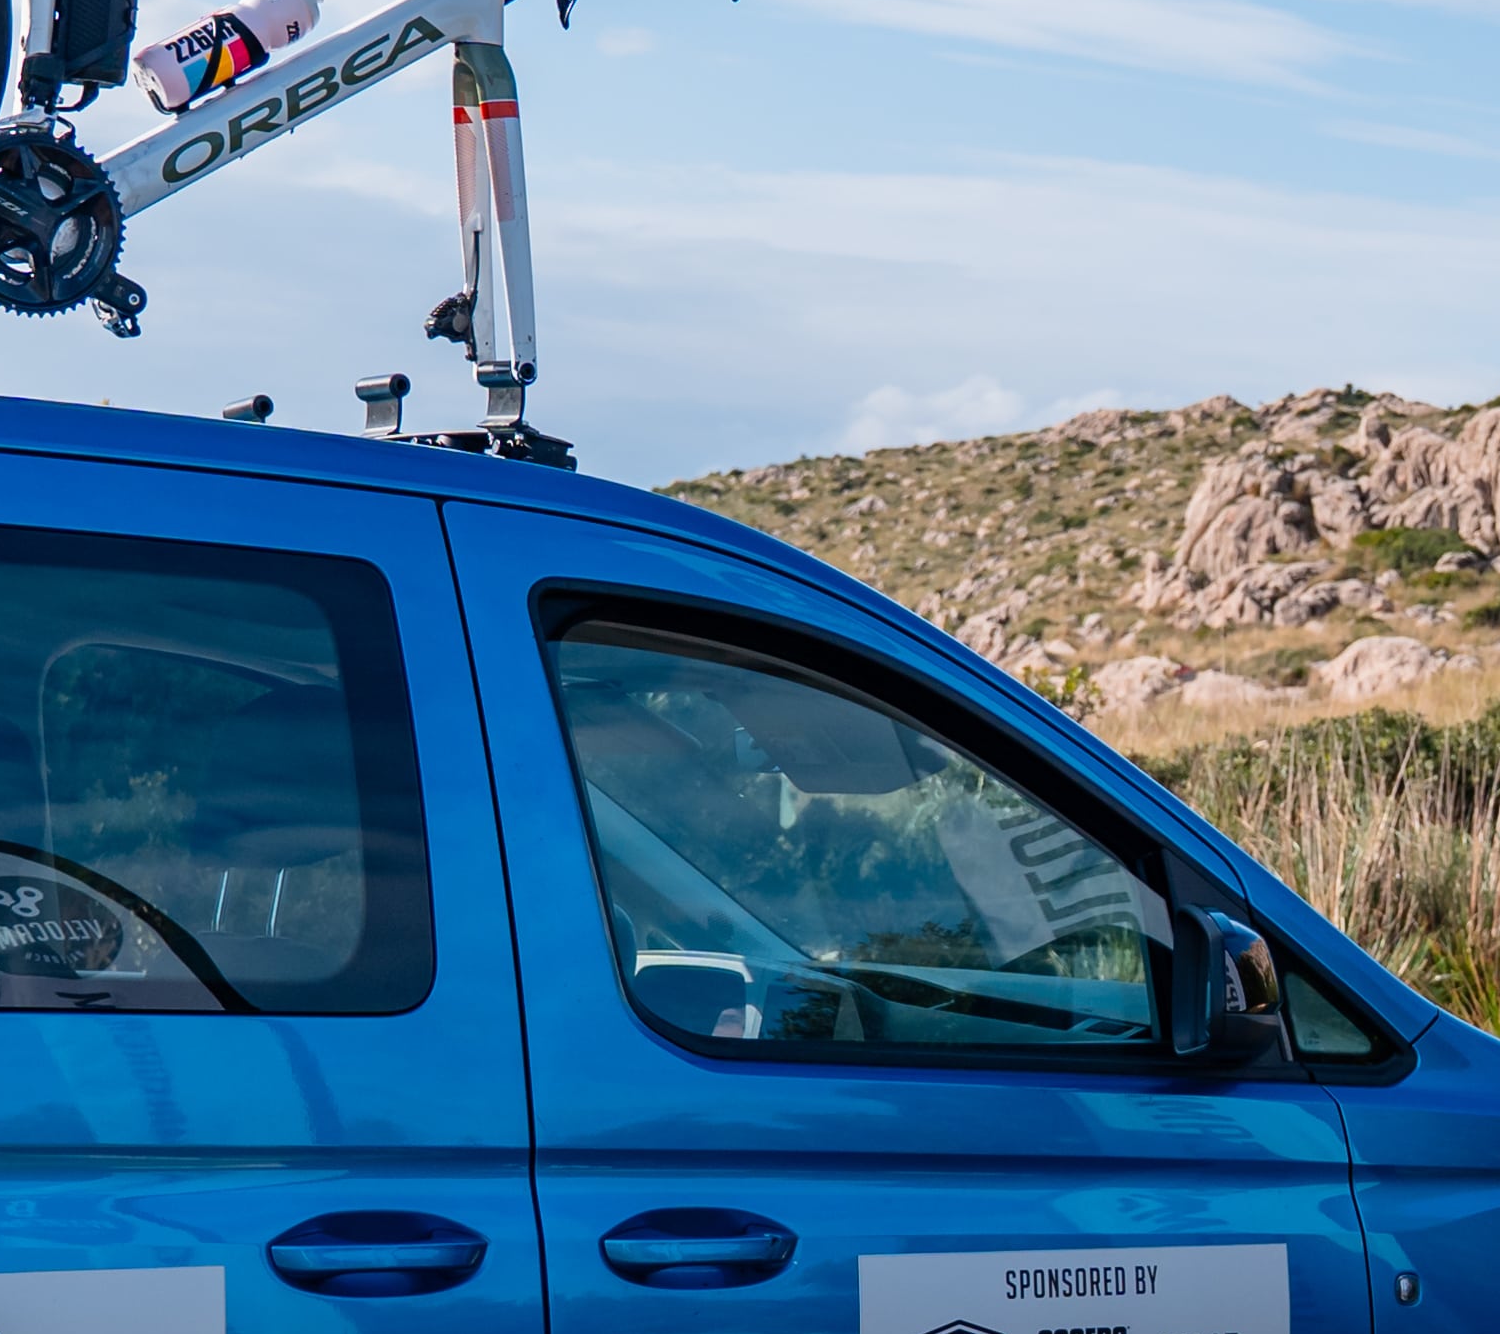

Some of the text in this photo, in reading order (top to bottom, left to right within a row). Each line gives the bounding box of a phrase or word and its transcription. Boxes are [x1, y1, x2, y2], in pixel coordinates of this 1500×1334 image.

[161, 14, 447, 185] ORBEA
[1005, 1265, 1158, 1300] SPONSORED BY
